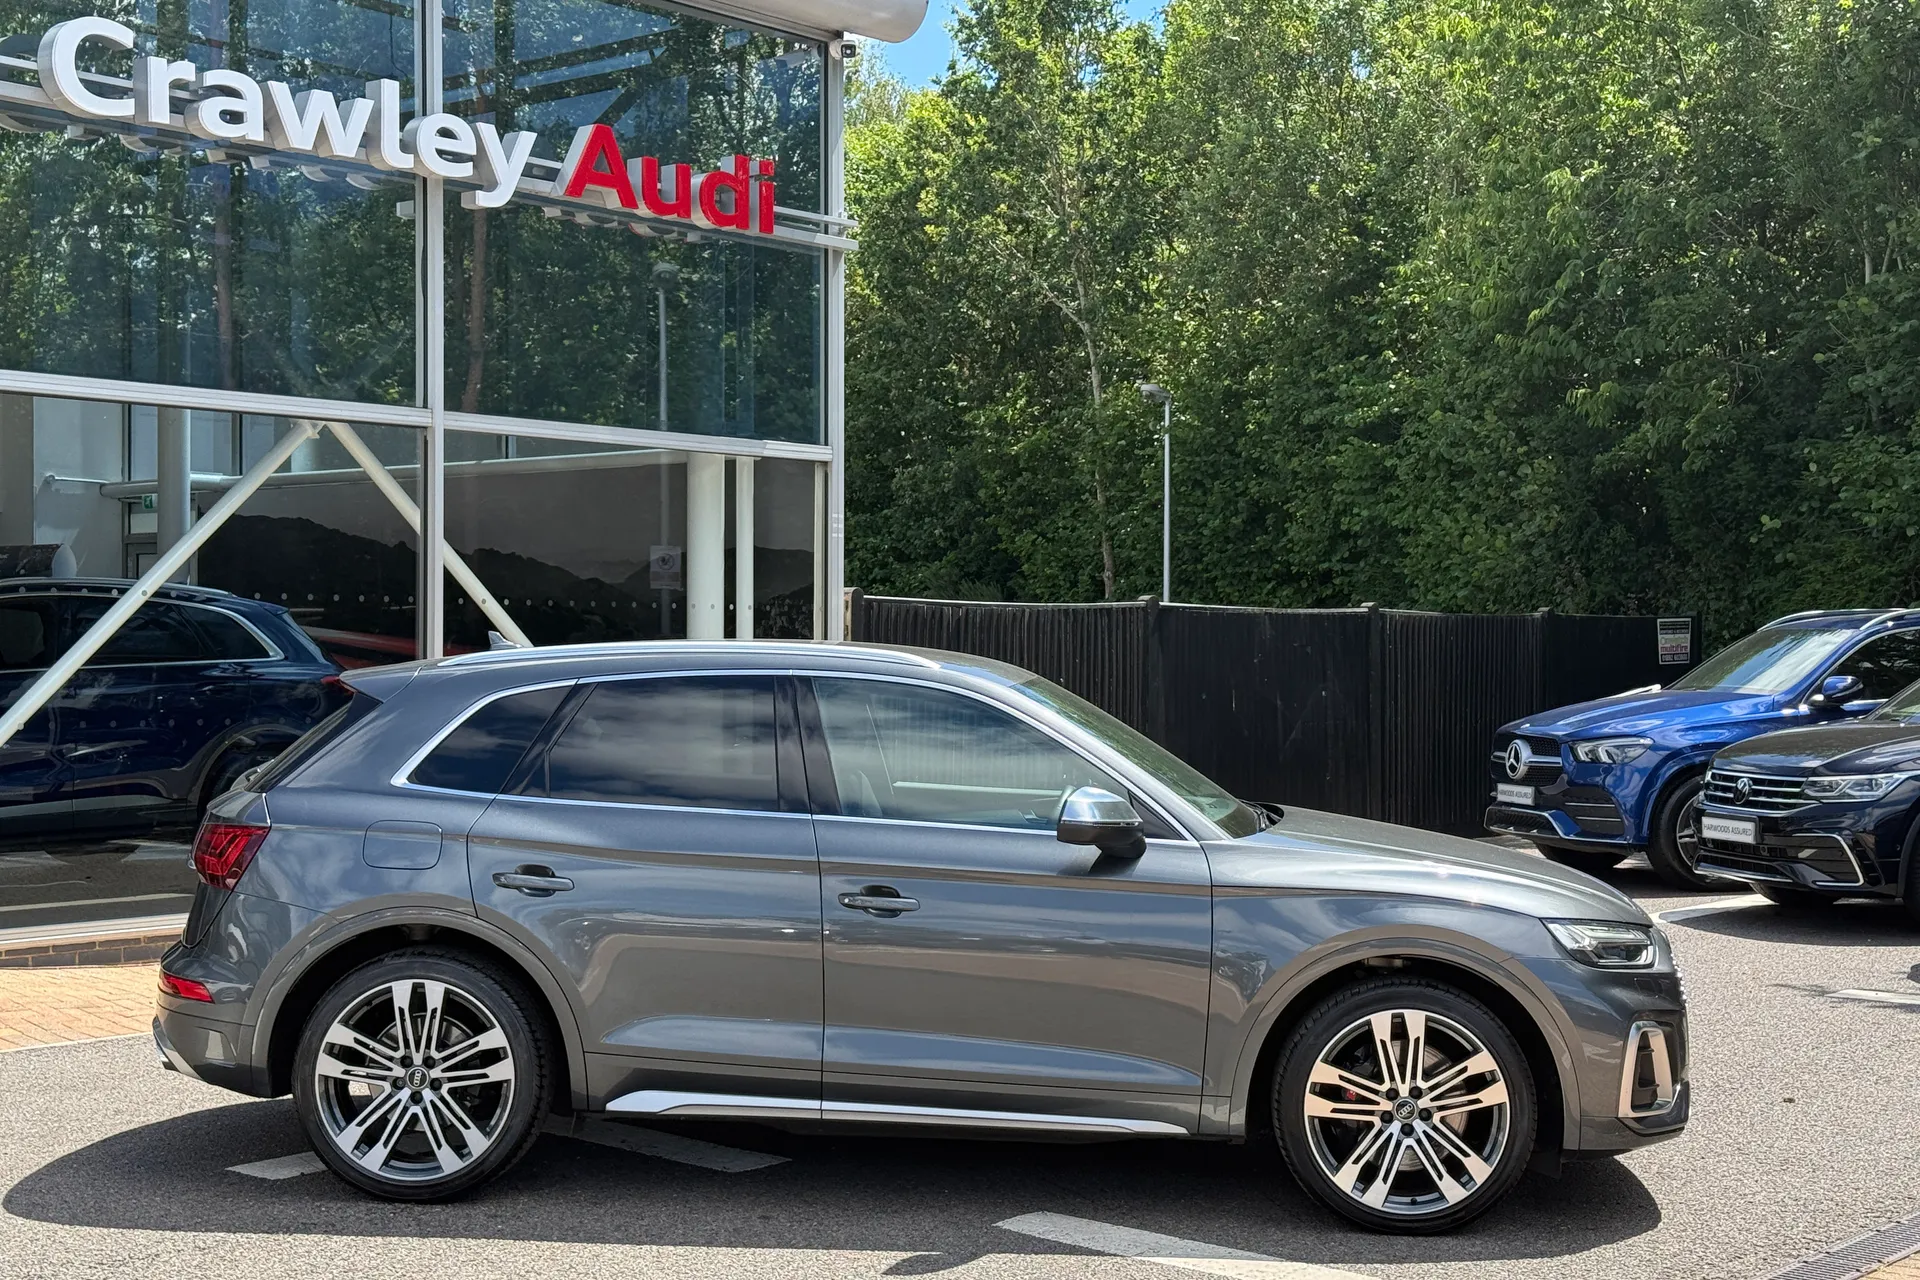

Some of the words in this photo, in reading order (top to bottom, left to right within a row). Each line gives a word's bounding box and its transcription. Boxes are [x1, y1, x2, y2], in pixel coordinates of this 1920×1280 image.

[39, 15, 538, 210] Crawley
[560, 122, 775, 235] Audi
[1704, 824, 1730, 833] HARWOODS
[1731, 826, 1752, 836] ASSURED
